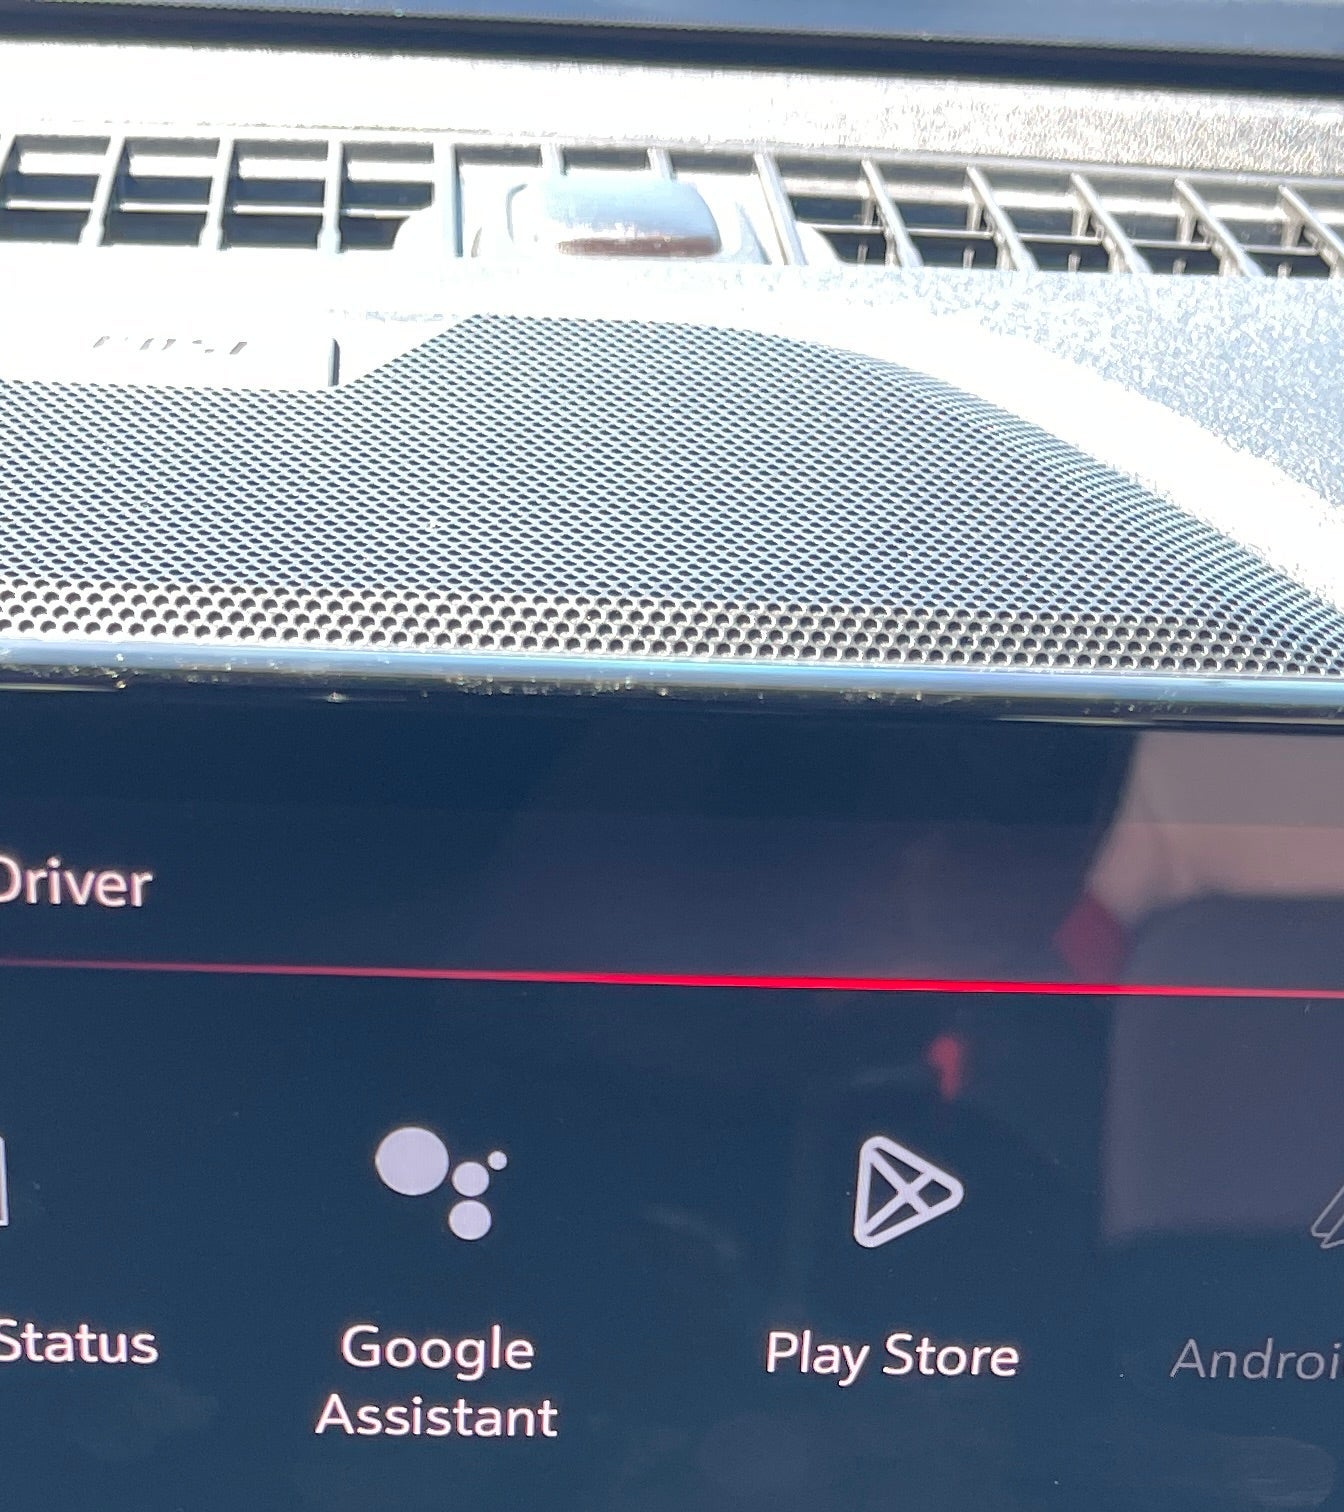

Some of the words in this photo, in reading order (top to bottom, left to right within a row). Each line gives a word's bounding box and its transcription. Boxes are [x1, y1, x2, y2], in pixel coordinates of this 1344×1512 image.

[342, 1324, 535, 1382] Google
[767, 1329, 871, 1387] Play
[882, 1332, 1020, 1377] Store
[314, 1393, 558, 1437] Assistant
